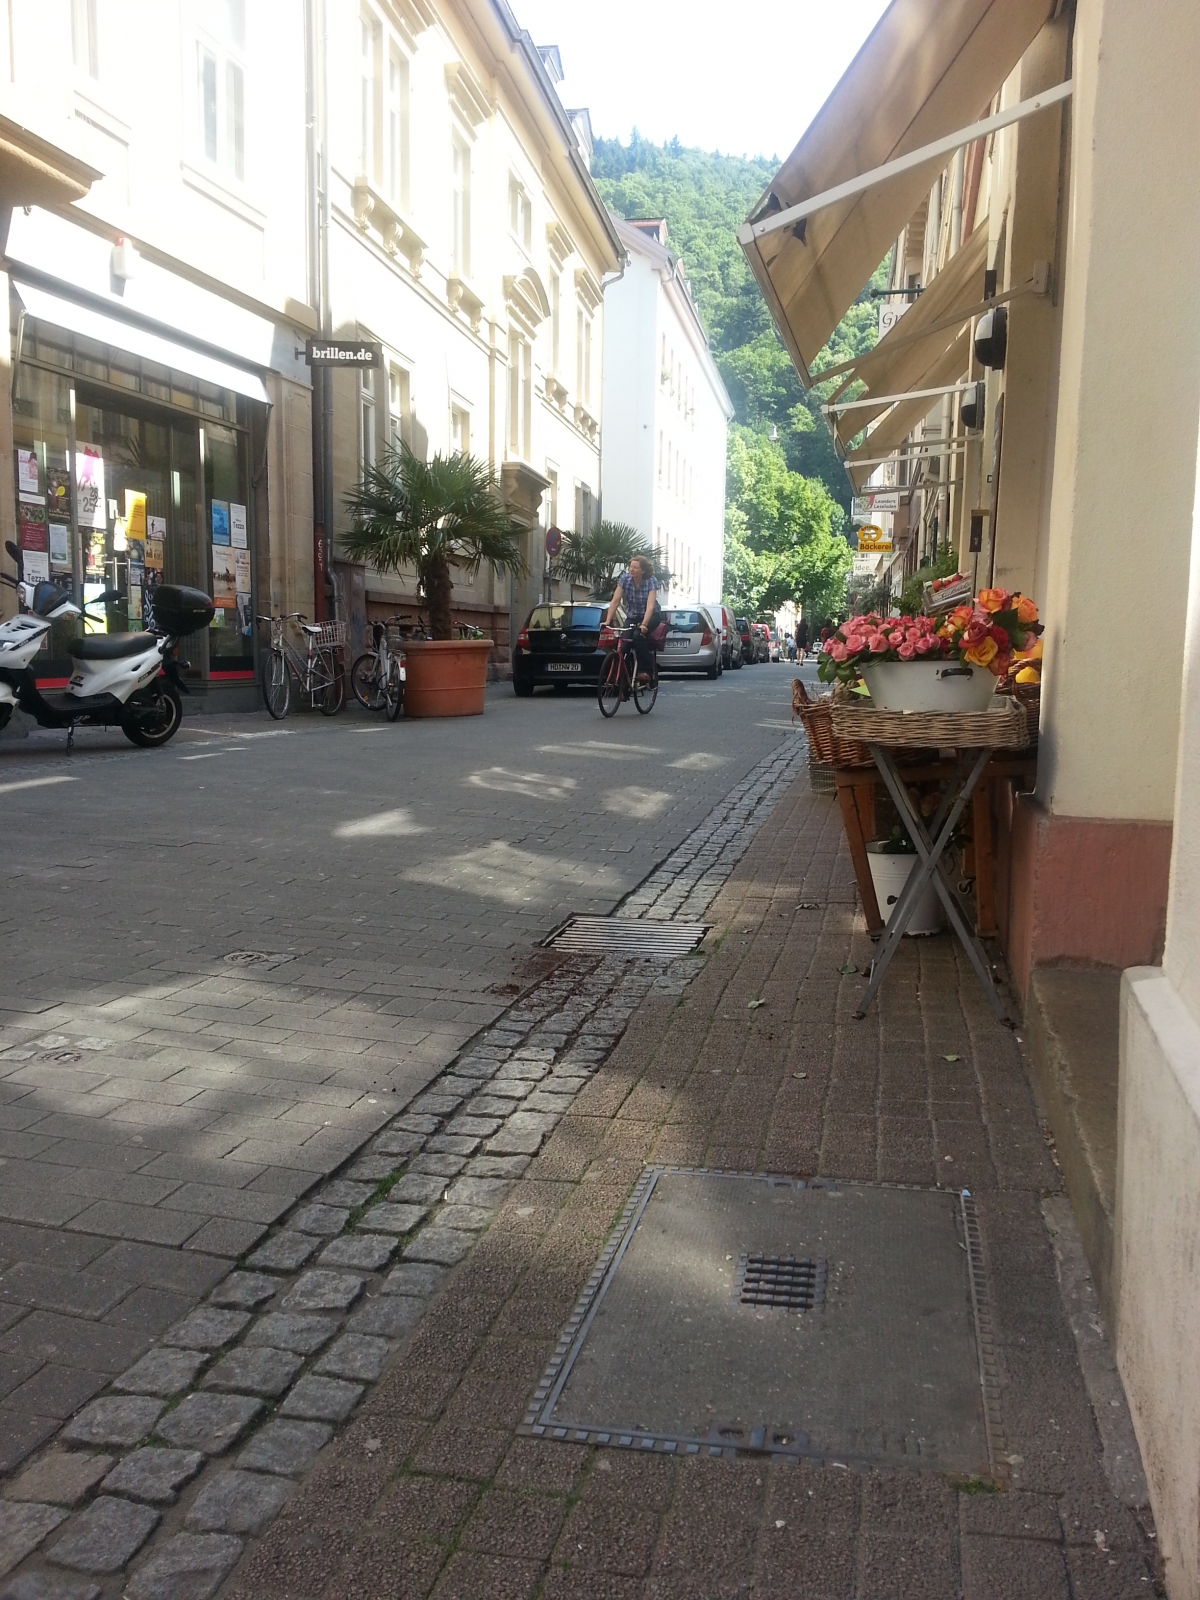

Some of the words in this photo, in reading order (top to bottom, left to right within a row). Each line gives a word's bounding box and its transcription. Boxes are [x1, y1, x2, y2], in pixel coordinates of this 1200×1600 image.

[312, 346, 373, 361] brillen.de
[860, 542, 892, 550] Bäckerei
[26, 573, 46, 582] Tezza
[571, 663, 579, 671] 20
